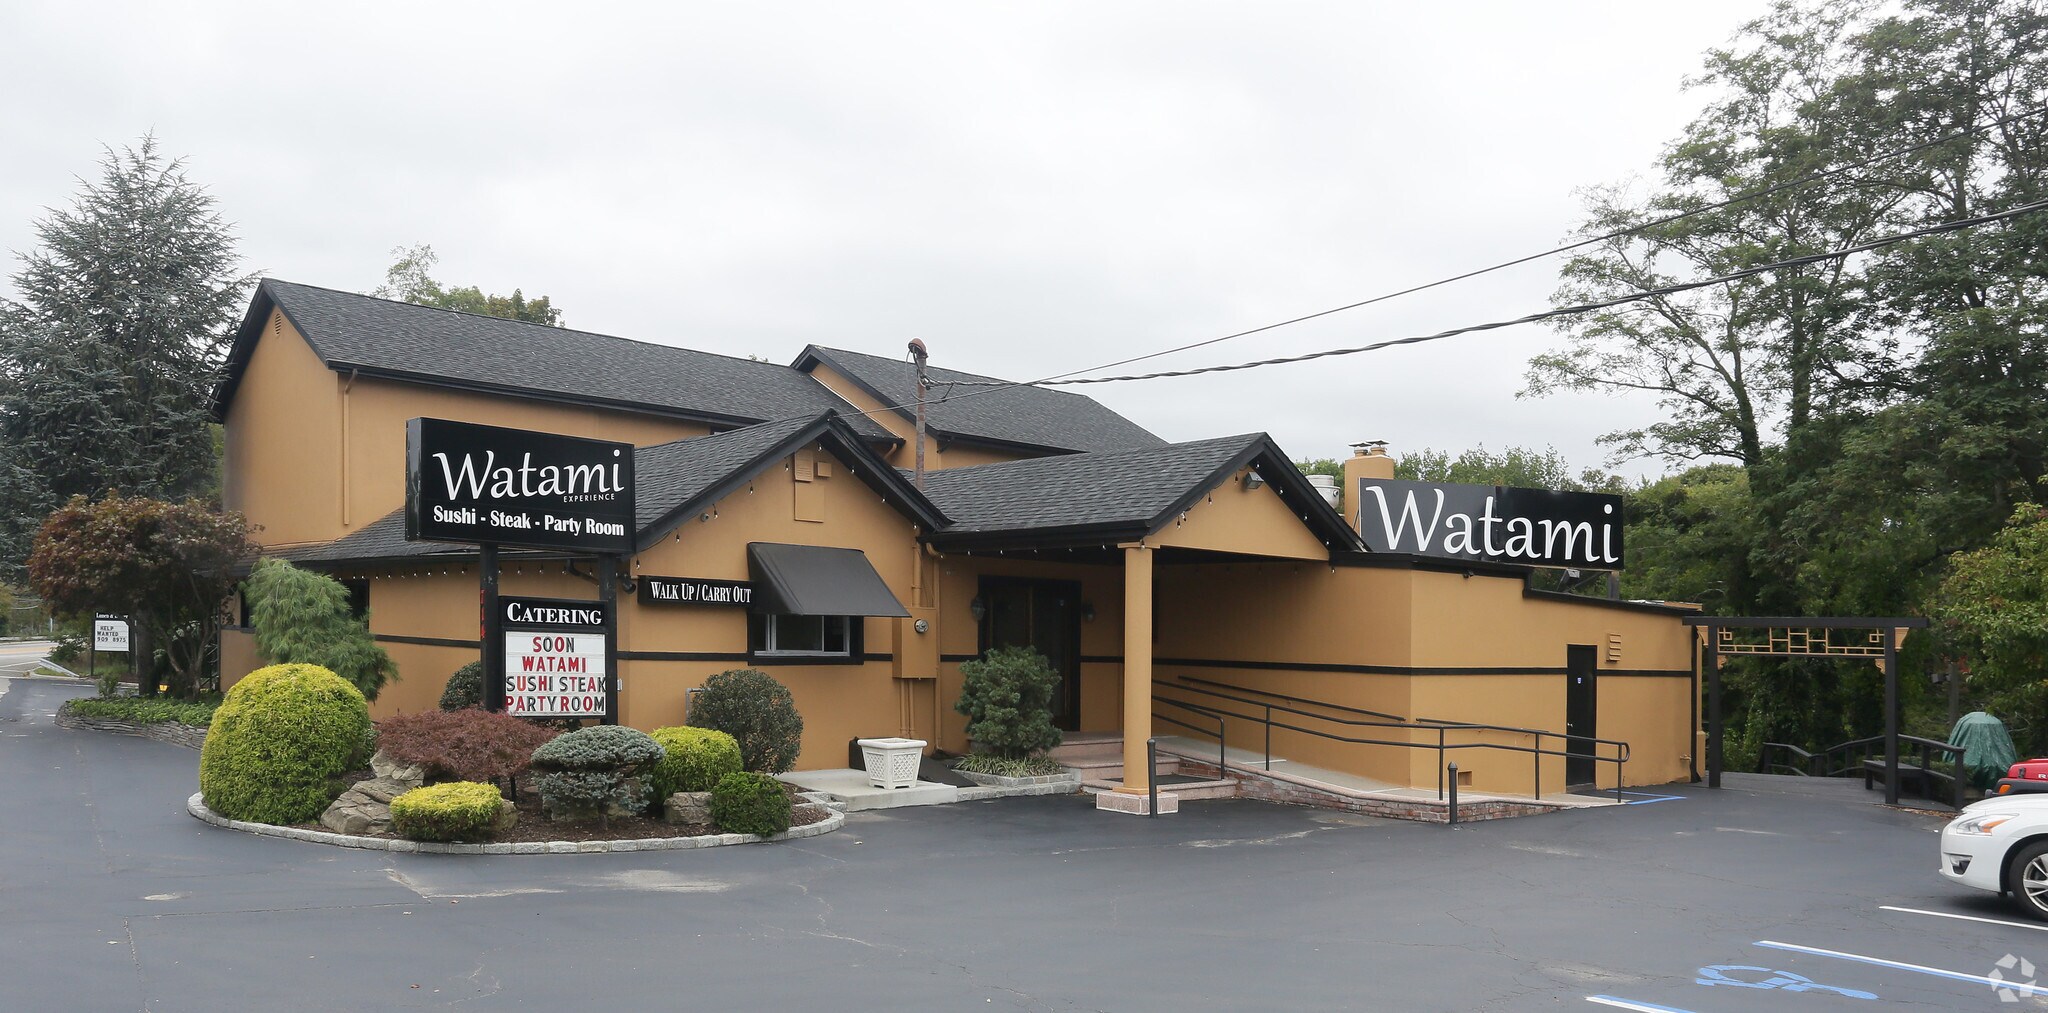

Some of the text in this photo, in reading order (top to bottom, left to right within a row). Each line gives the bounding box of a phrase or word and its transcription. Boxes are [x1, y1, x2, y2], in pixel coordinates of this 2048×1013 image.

[432, 449, 625, 501] Watami
[563, 493, 615, 503] EXPERIENCE
[433, 505, 477, 525] Sushi
[490, 510, 532, 529] Steak
[544, 514, 582, 536] Party
[585, 518, 625, 536] Room
[1365, 485, 1619, 564] Watami
[650, 581, 680, 600] WALK
[681, 583, 695, 601] UP
[701, 584, 732, 602] CARRY
[733, 585, 752, 603] OUT
[506, 602, 602, 625] CATERING
[532, 636, 575, 653] SOON
[522, 656, 587, 673] WATAMI
[506, 675, 606, 693] SUSHI STEAK
[505, 695, 605, 712] PARTY ROOM
